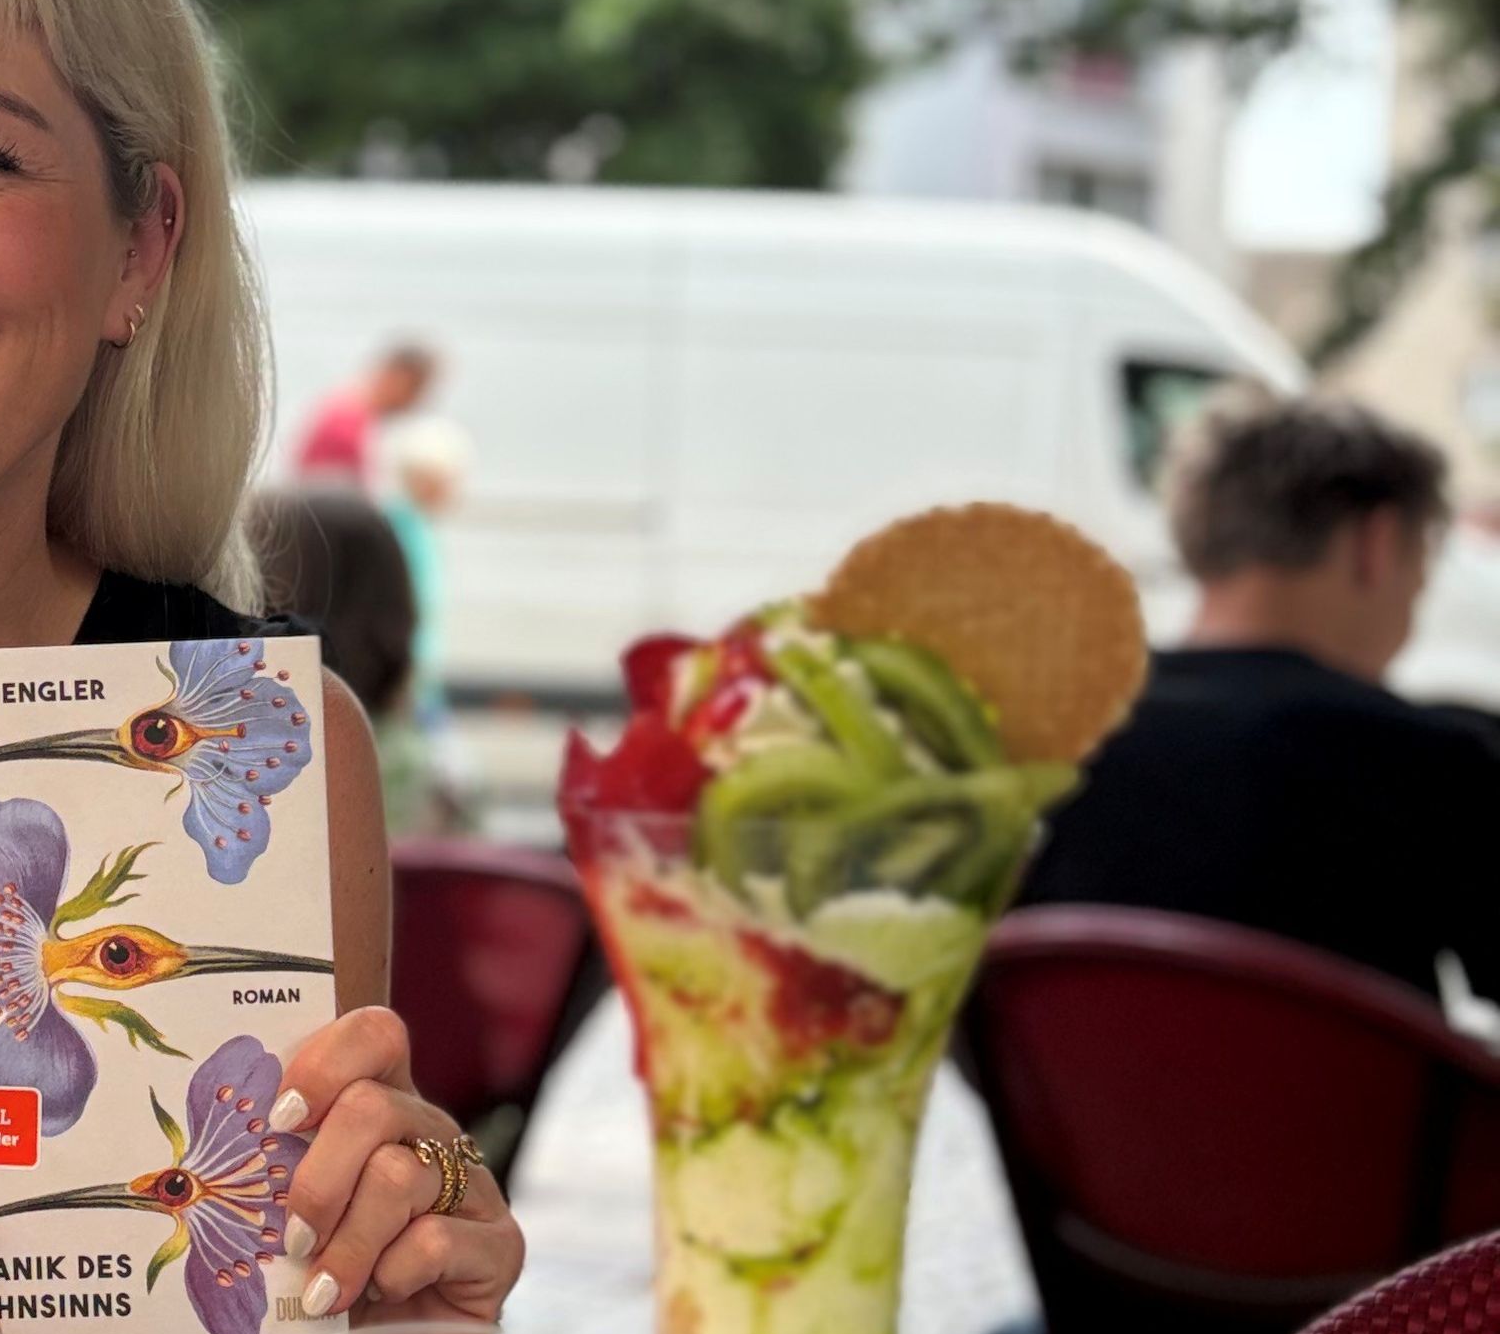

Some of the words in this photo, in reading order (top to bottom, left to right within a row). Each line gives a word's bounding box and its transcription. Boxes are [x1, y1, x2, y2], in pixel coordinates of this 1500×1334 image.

[2, 678, 105, 704] ENGLER
[232, 988, 300, 1005] ROMAN
[78, 1253, 133, 1280] DES
